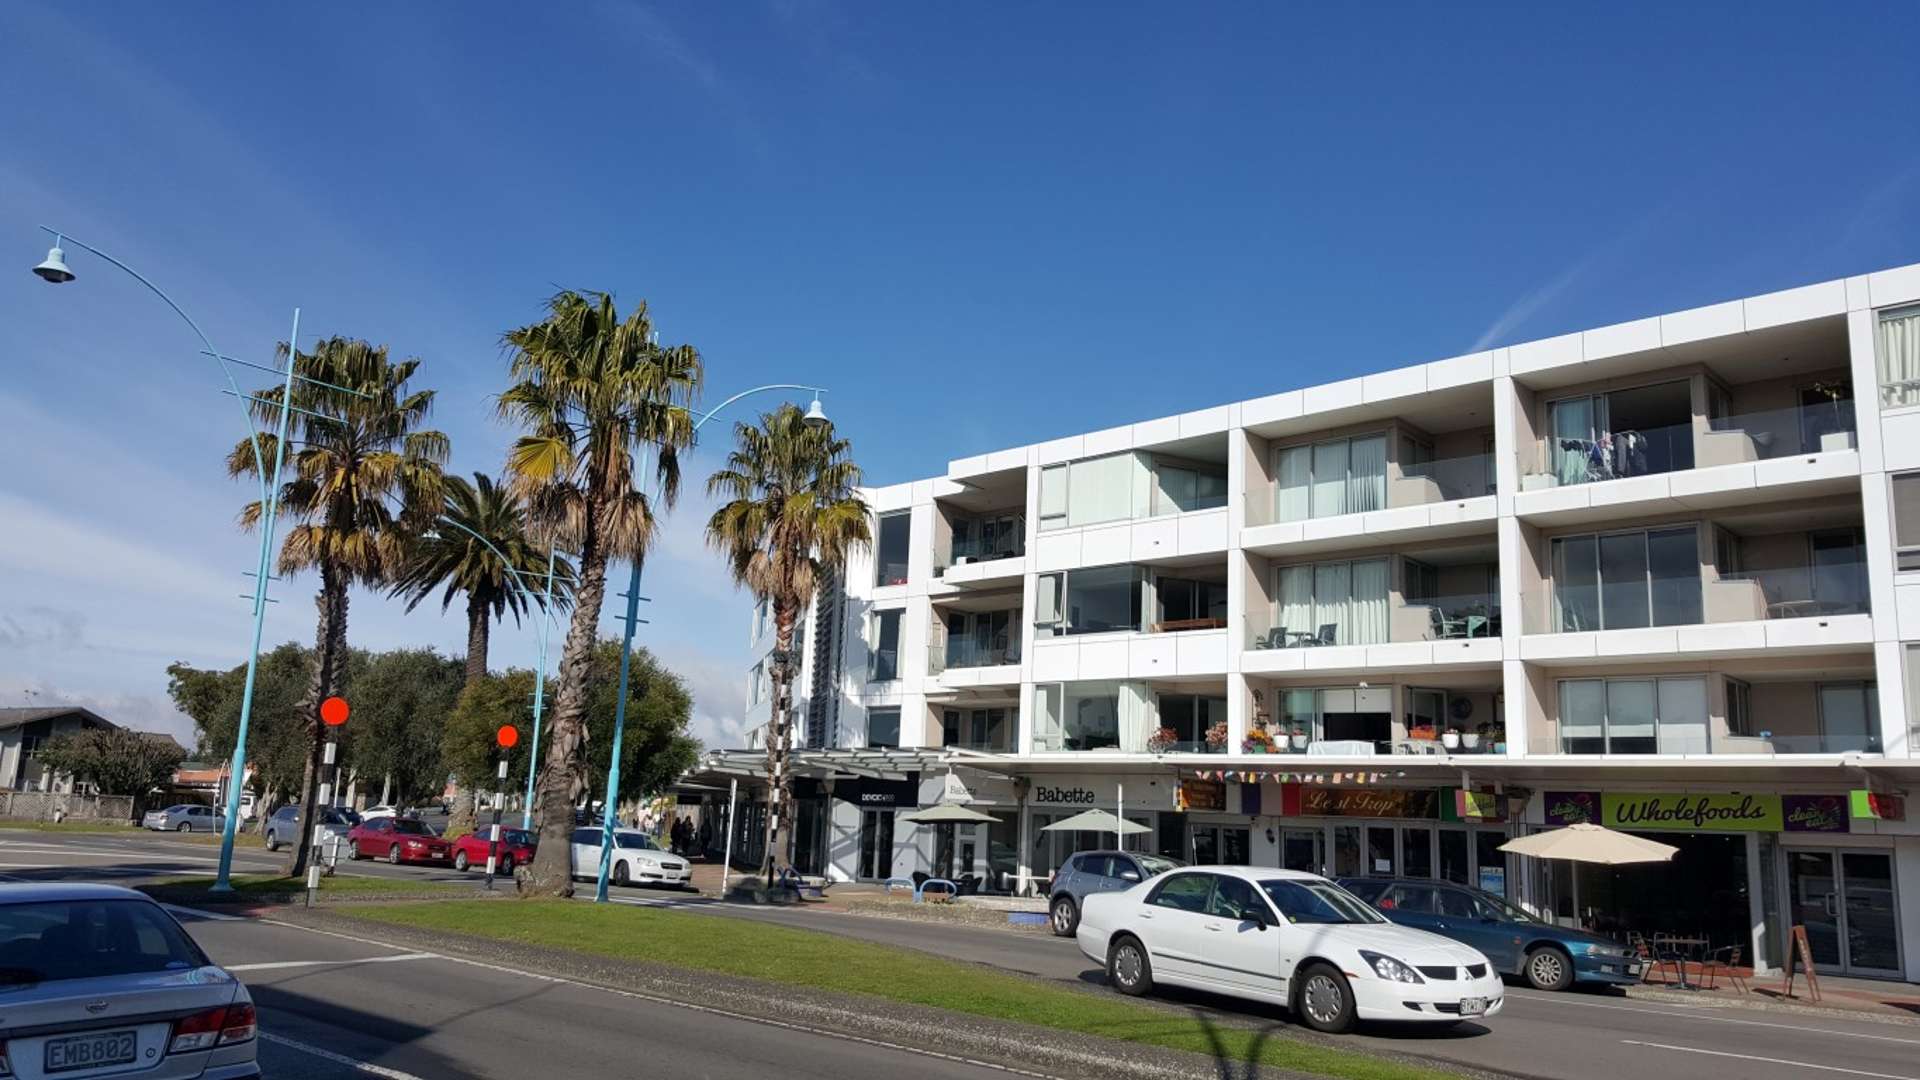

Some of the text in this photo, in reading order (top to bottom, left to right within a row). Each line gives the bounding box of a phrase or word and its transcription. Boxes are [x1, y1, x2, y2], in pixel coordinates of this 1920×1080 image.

[1036, 786, 1095, 803] Babette
[1616, 796, 1766, 827] Wholefoods
[50, 1037, 133, 1066] EMB802
